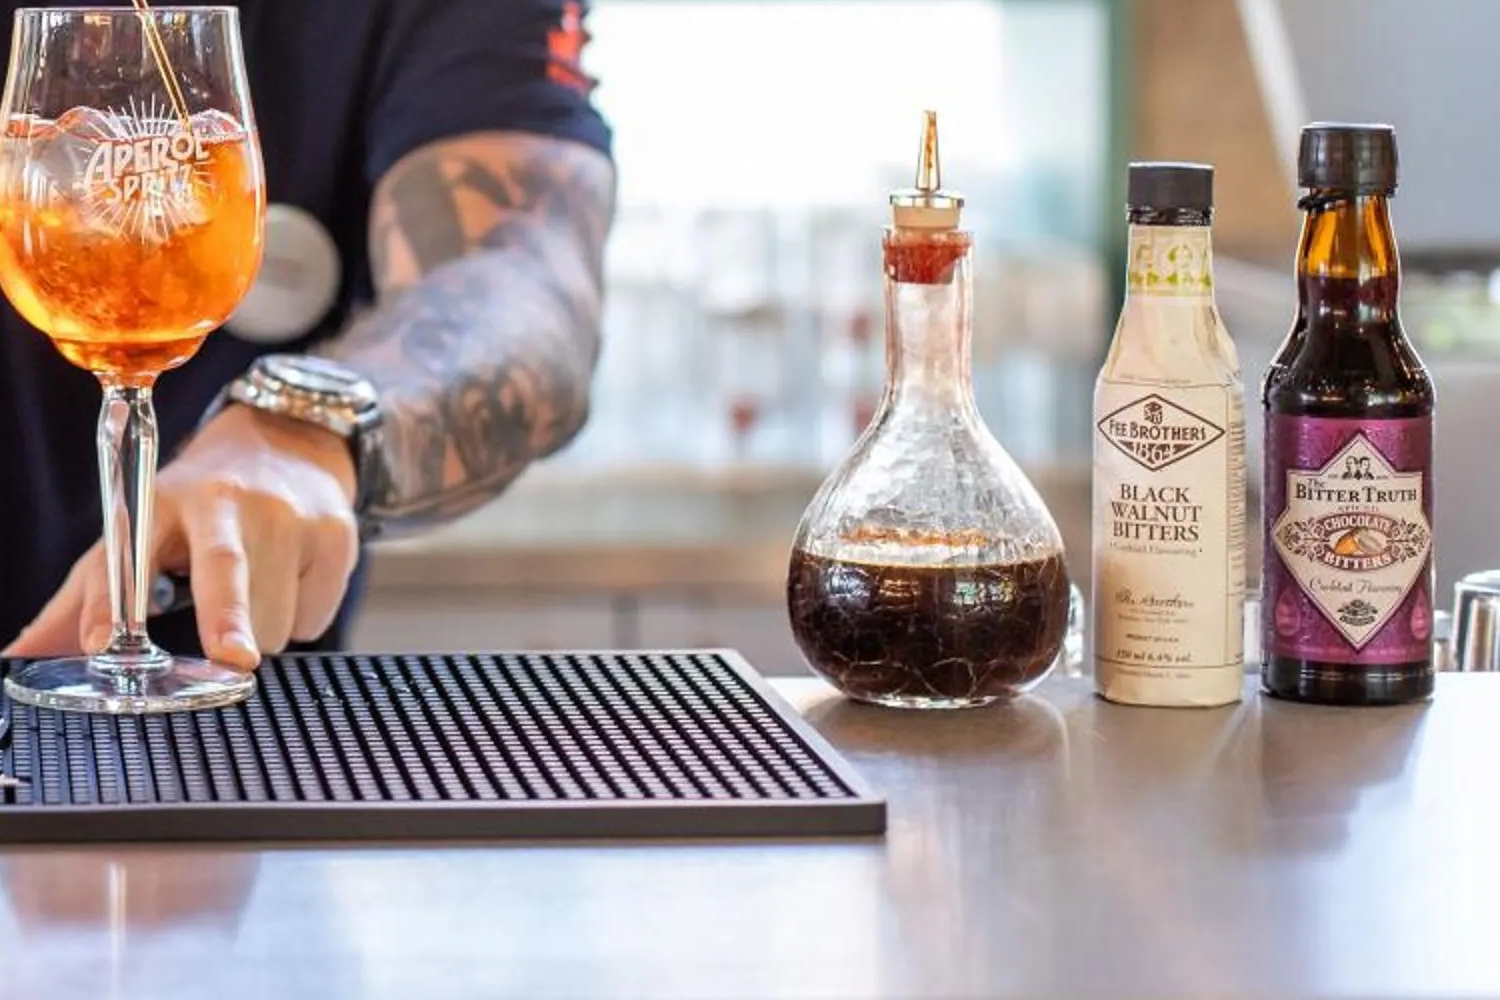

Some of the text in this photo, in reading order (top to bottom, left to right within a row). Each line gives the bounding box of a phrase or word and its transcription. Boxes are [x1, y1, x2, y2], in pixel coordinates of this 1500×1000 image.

[84, 129, 210, 193] APEROL
[1109, 420, 1206, 441] FEE BROTHERS
[1120, 483, 1190, 503] BLACK
[1295, 483, 1417, 503] BITTER TRUTH
[1111, 501, 1202, 523] WALNUT
[1113, 521, 1199, 542] BITTERS
[1323, 514, 1392, 533] CHOCOLATE
[1324, 553, 1392, 569] BITTERS
